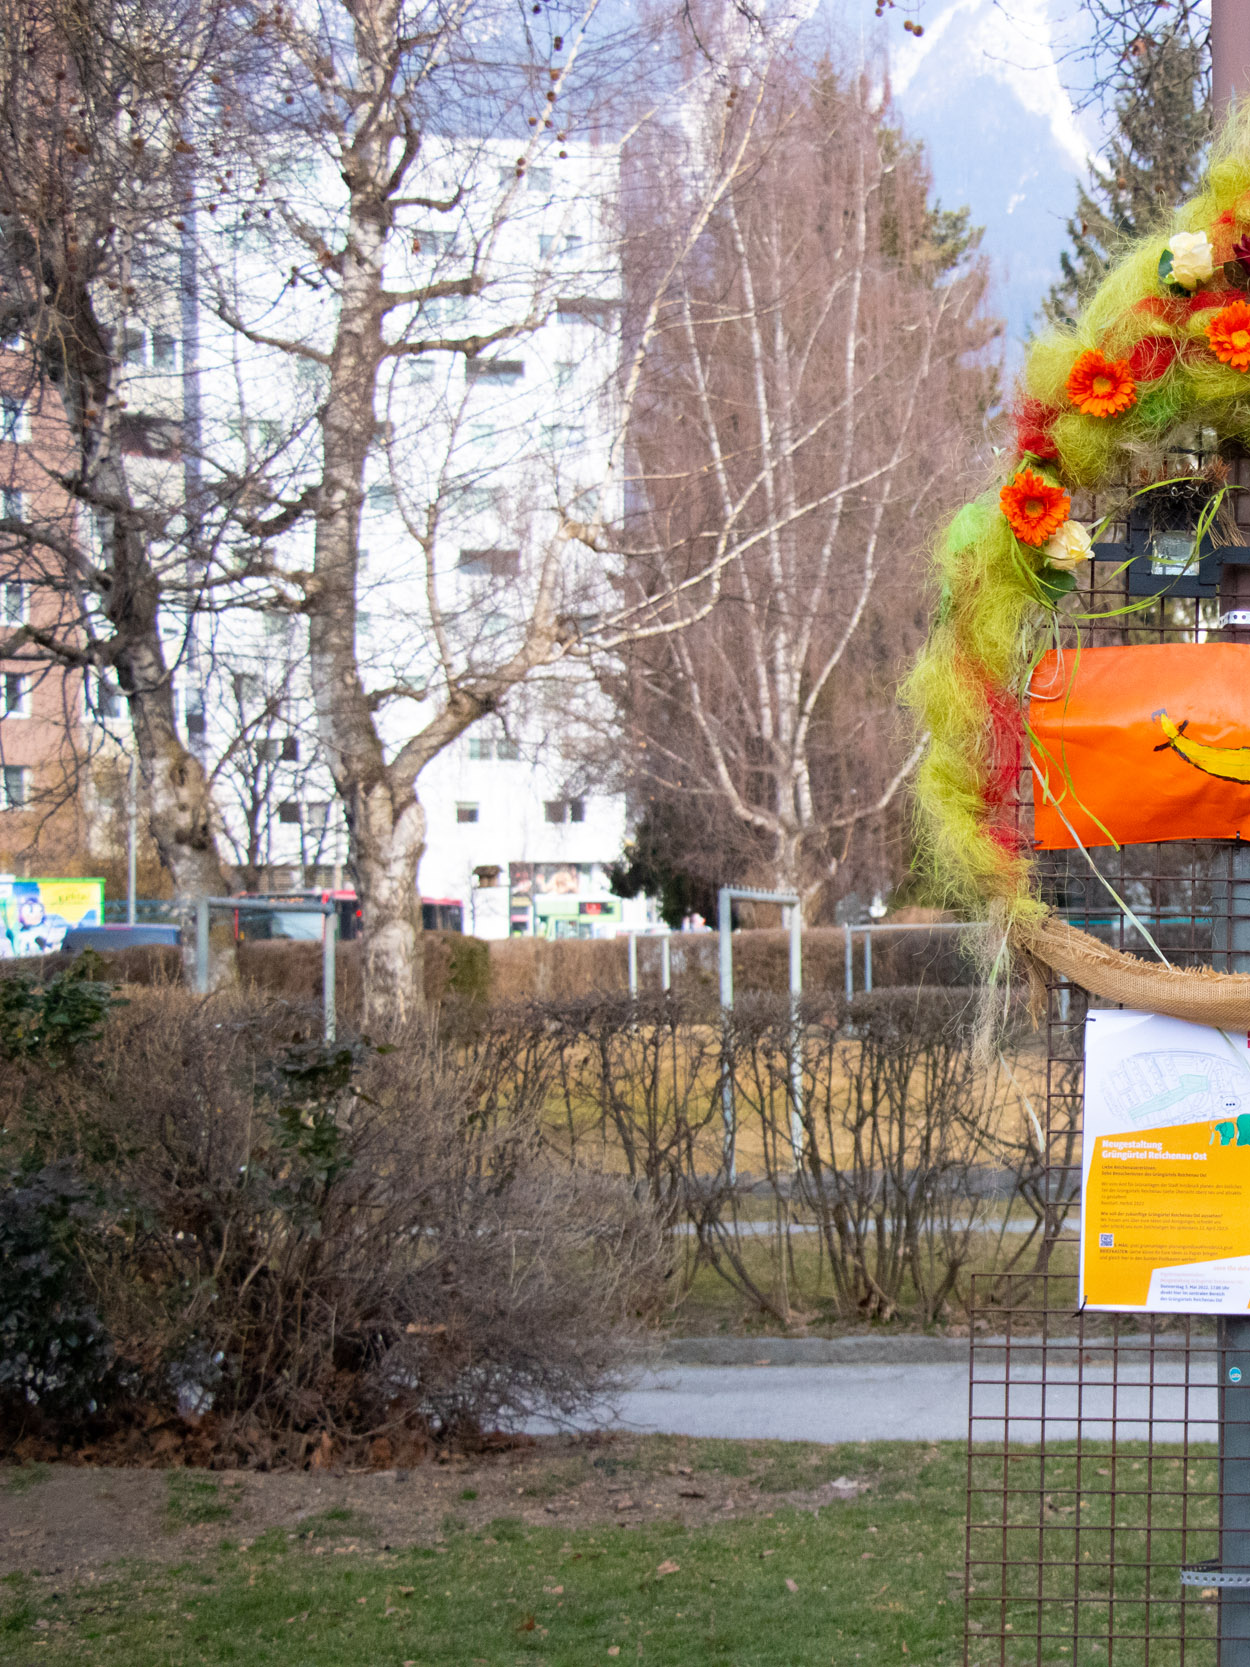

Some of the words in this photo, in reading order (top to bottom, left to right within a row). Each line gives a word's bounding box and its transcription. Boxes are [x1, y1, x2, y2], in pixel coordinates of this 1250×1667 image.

[1102, 1140, 1163, 1151] Neugestaltung
[1102, 1150, 1146, 1161] Grüngürtel
[1148, 1151, 1191, 1160] Reichenau
[1193, 1152, 1207, 1161] Ost
